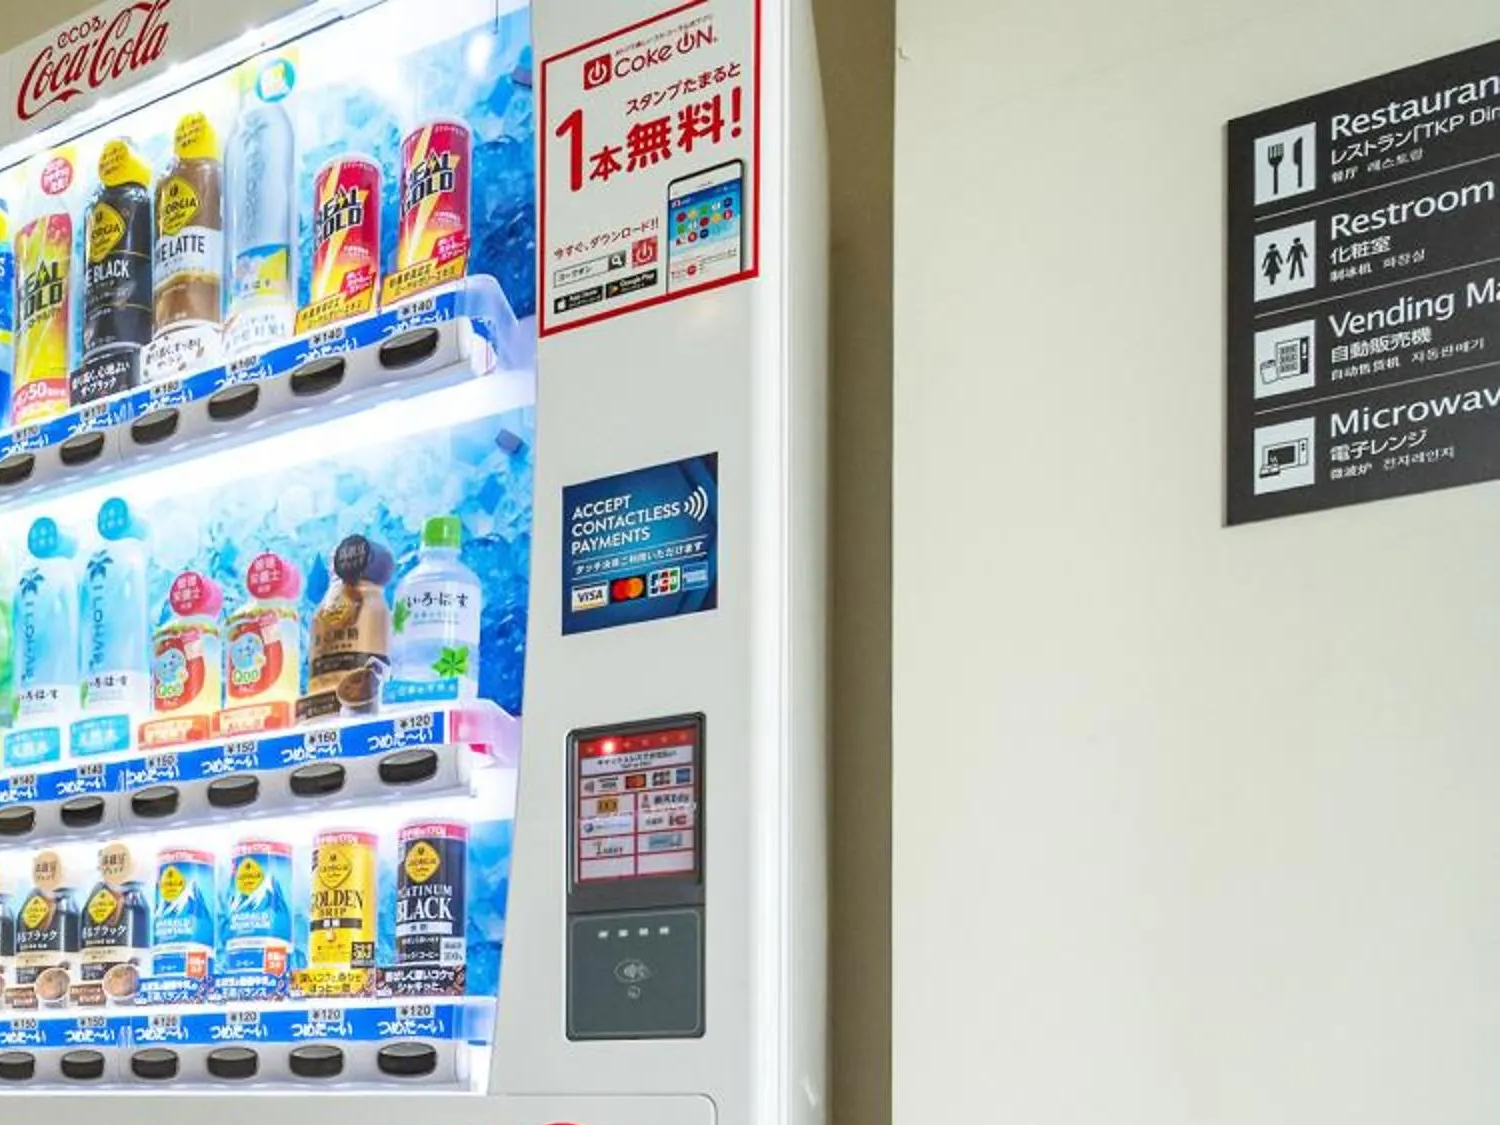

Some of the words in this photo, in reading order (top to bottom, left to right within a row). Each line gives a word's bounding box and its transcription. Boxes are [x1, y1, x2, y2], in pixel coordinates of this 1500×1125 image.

[625, 62, 742, 115] スタンプたまると
[1331, 180, 1495, 240] Restroom
[168, 235, 205, 257] LATTE
[1329, 235, 1391, 265] 化粧室
[402, 300, 433, 315] ¥140
[1328, 293, 1455, 338] Vending
[1467, 277, 1500, 308] M
[1331, 326, 1433, 364] 自動販売機
[1329, 427, 1428, 462] 電子レンジ
[572, 494, 631, 520] ACCEPT
[572, 501, 681, 536] CONTACTLESS
[572, 527, 650, 555] PAYMENTS
[577, 589, 603, 602] VISA
[401, 715, 431, 729] ¥120
[229, 1011, 257, 1024] ¥120
[312, 1008, 341, 1021] ¥120
[400, 1004, 431, 1017] ¥120
